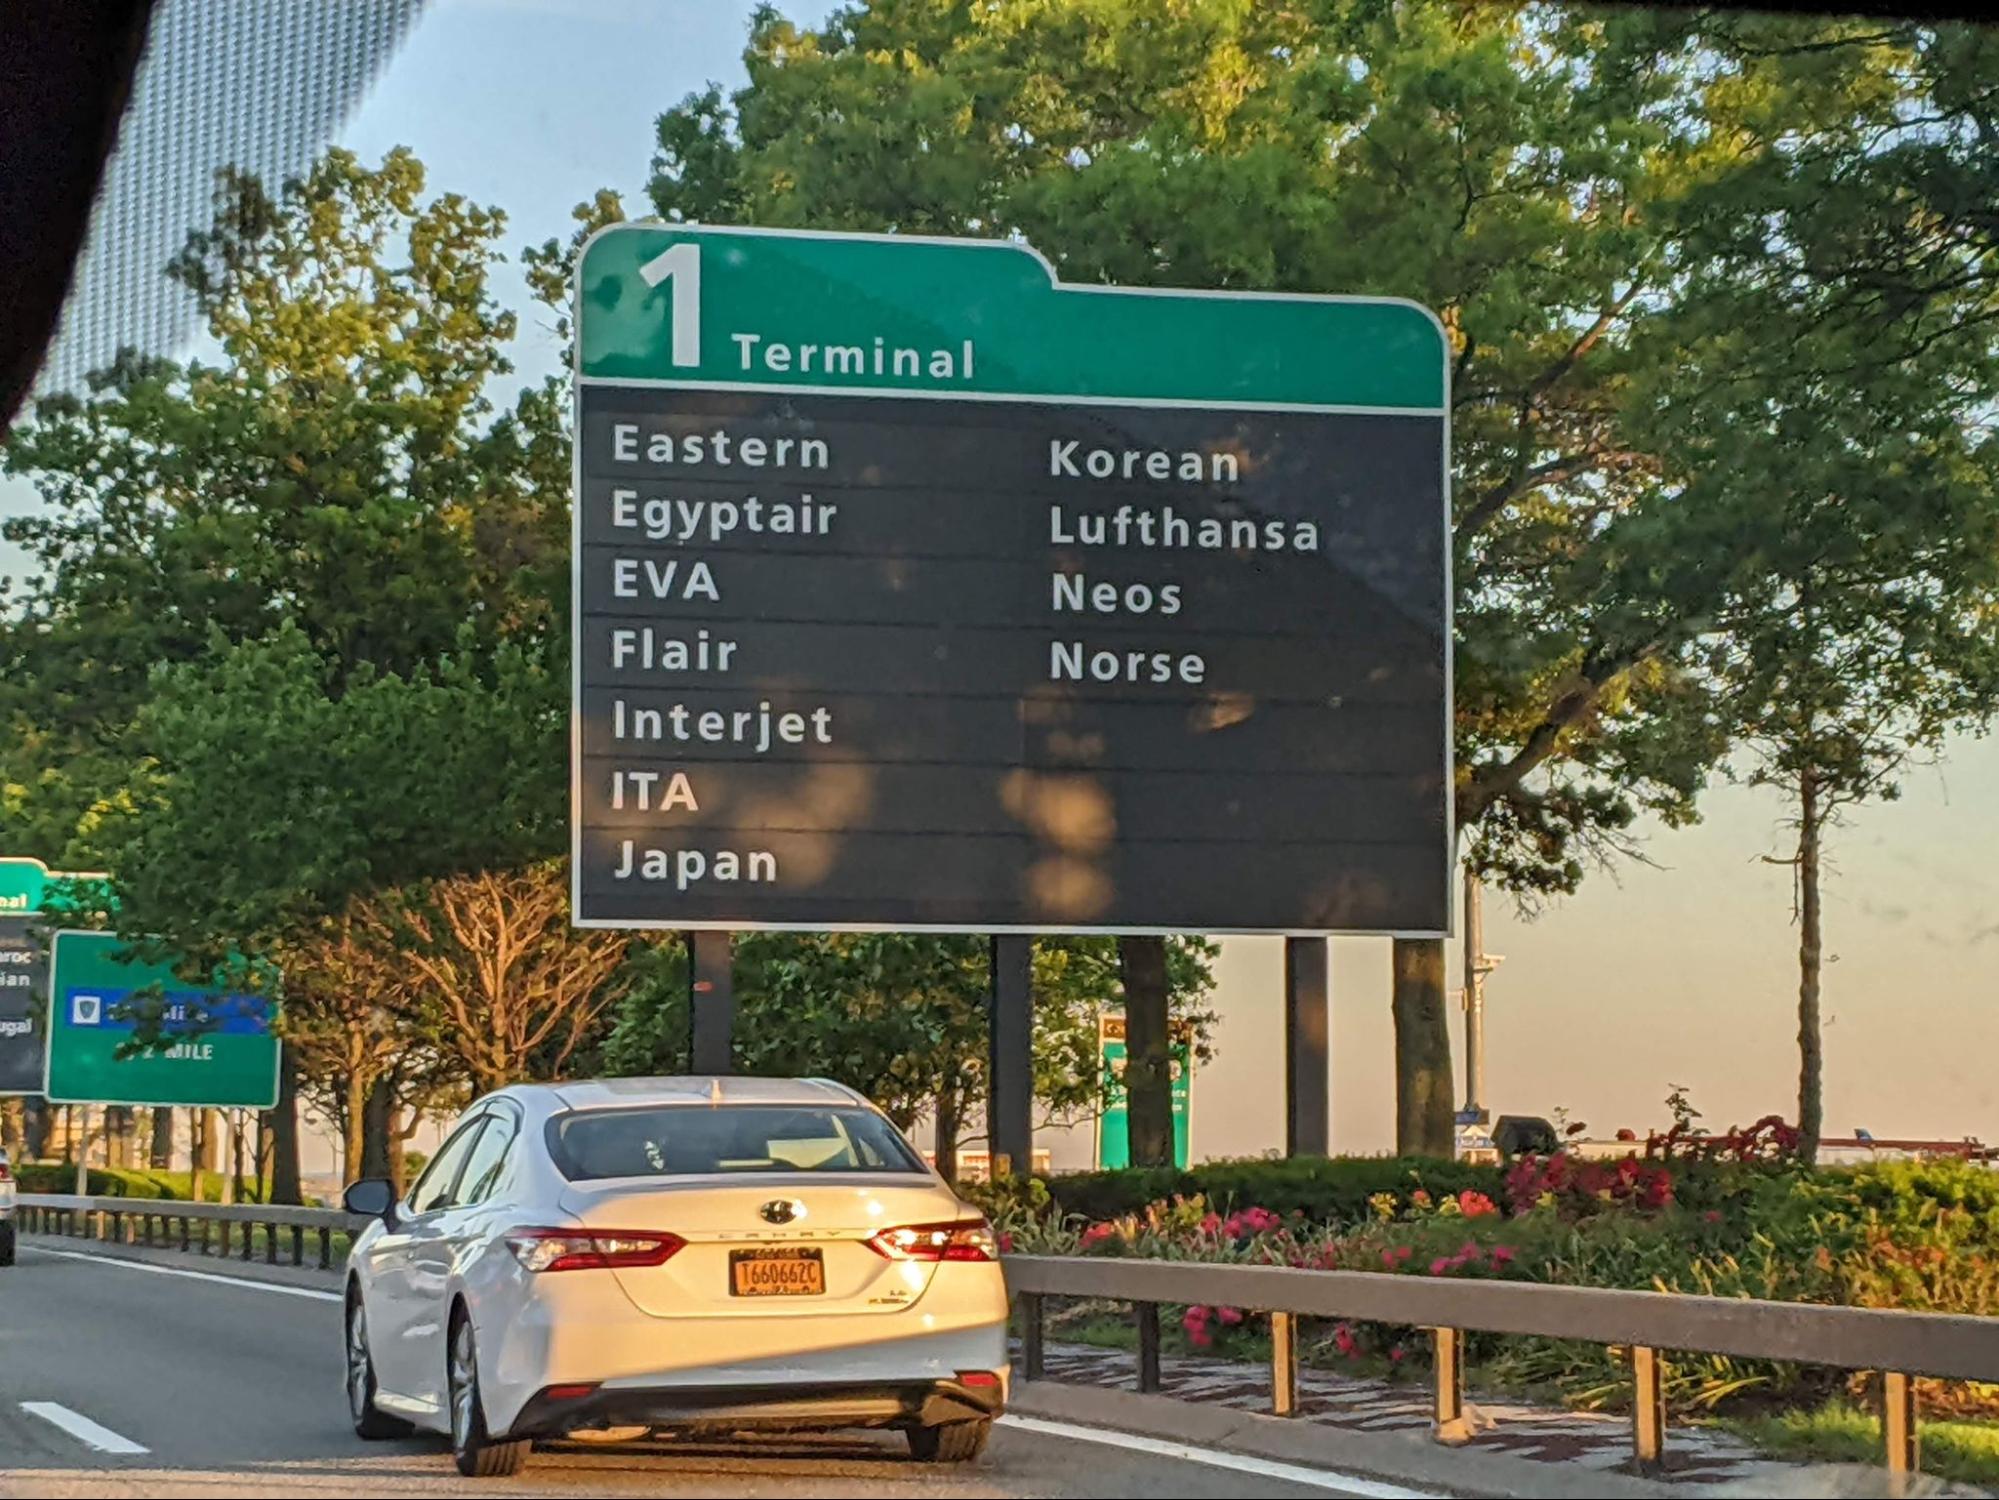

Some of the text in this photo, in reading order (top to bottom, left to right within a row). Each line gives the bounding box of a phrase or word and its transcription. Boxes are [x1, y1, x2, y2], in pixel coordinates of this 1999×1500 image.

[639, 243, 701, 367] 1
[732, 333, 975, 381] Terminal
[613, 423, 830, 470] Eastern
[1049, 440, 1240, 482] Korean
[613, 489, 838, 541] Egyptair
[1050, 505, 1319, 553] Lufthansa
[613, 558, 720, 601] EVA
[1051, 572, 1182, 615] Neos
[613, 628, 738, 673] Flair
[1050, 641, 1206, 684] Norse
[614, 700, 833, 753] Interjet
[612, 771, 700, 813] ITA
[614, 841, 777, 891] Japan
[742, 1262, 817, 1284] T660662C
